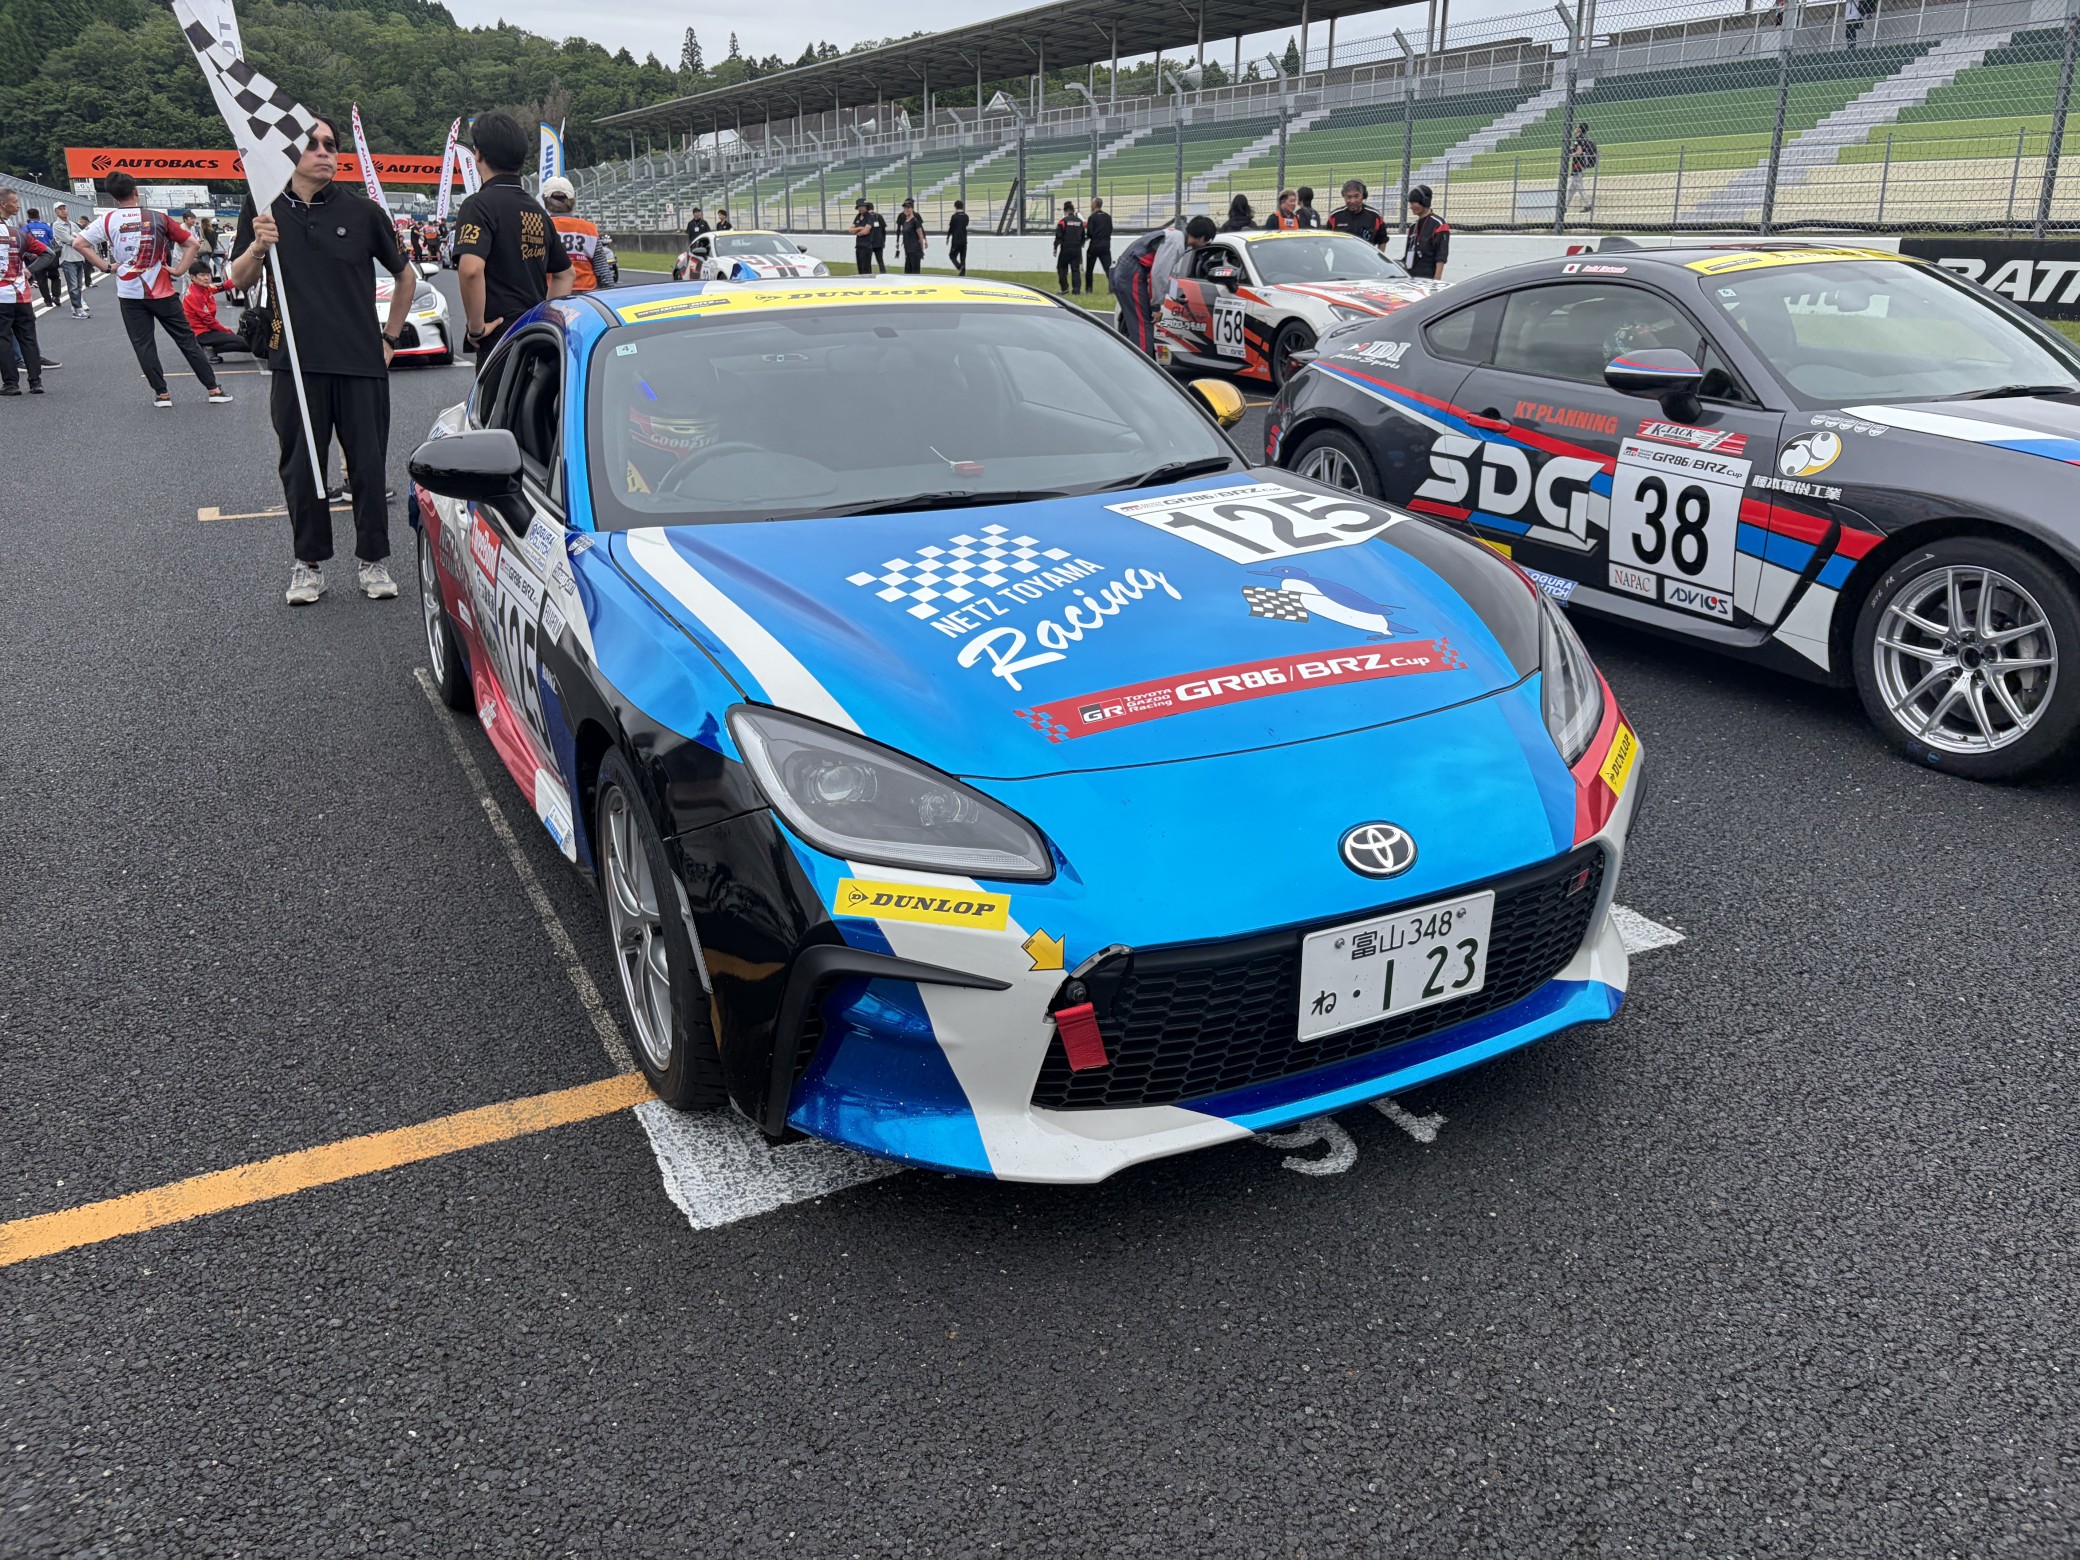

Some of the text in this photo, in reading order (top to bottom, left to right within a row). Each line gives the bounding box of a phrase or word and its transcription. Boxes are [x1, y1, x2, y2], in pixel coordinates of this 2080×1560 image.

[114, 158, 219, 169] AUTOBACS
[460, 223, 481, 240] 123
[787, 289, 938, 300] DUNLOP
[1214, 309, 1243, 345] 758
[1514, 401, 1619, 435] KT PLANNING
[1651, 424, 1697, 438] K-TACK
[1413, 434, 1607, 552] SDG
[1751, 474, 1843, 501] 藤本電機工業
[1162, 494, 1392, 555] 125
[1631, 476, 1710, 576] 38
[1530, 572, 1573, 591] OGURA
[1614, 569, 1651, 593] NAPAC
[929, 558, 1106, 639] NETZ TOYAMA
[956, 568, 1183, 692] Racing
[496, 590, 552, 756] 125
[1174, 653, 1430, 701] GR86/BRZ Cup
[1123, 688, 1172, 702] TOYOTA
[1126, 695, 1171, 708] GAZOO
[1128, 700, 1173, 713] Racing
[1611, 733, 1631, 778] DUNLOP
[869, 892, 996, 917] DUNLOP
